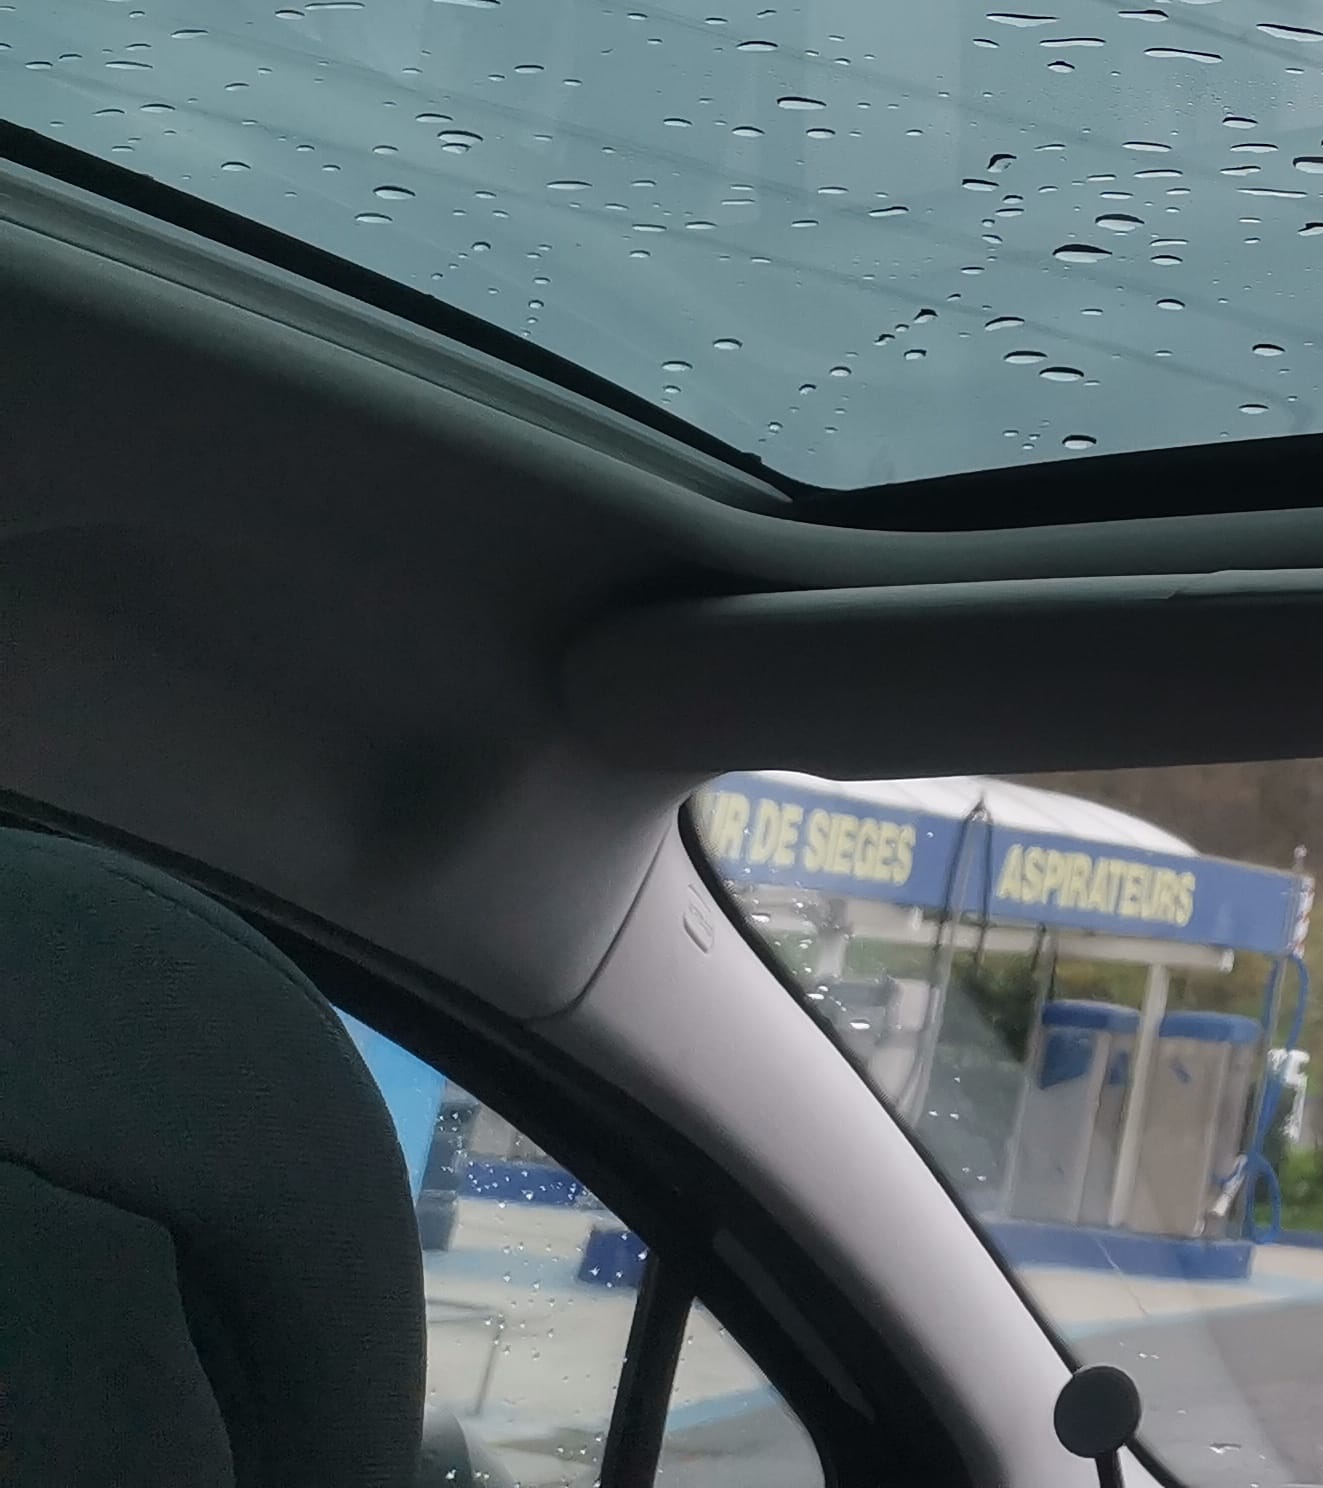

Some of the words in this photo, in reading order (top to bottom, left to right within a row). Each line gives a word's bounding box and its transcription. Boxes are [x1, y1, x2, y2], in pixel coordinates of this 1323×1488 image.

[750, 798, 804, 868] DE
[803, 807, 917, 886] SIEGES
[996, 843, 1197, 928] ASPIRATEURS
